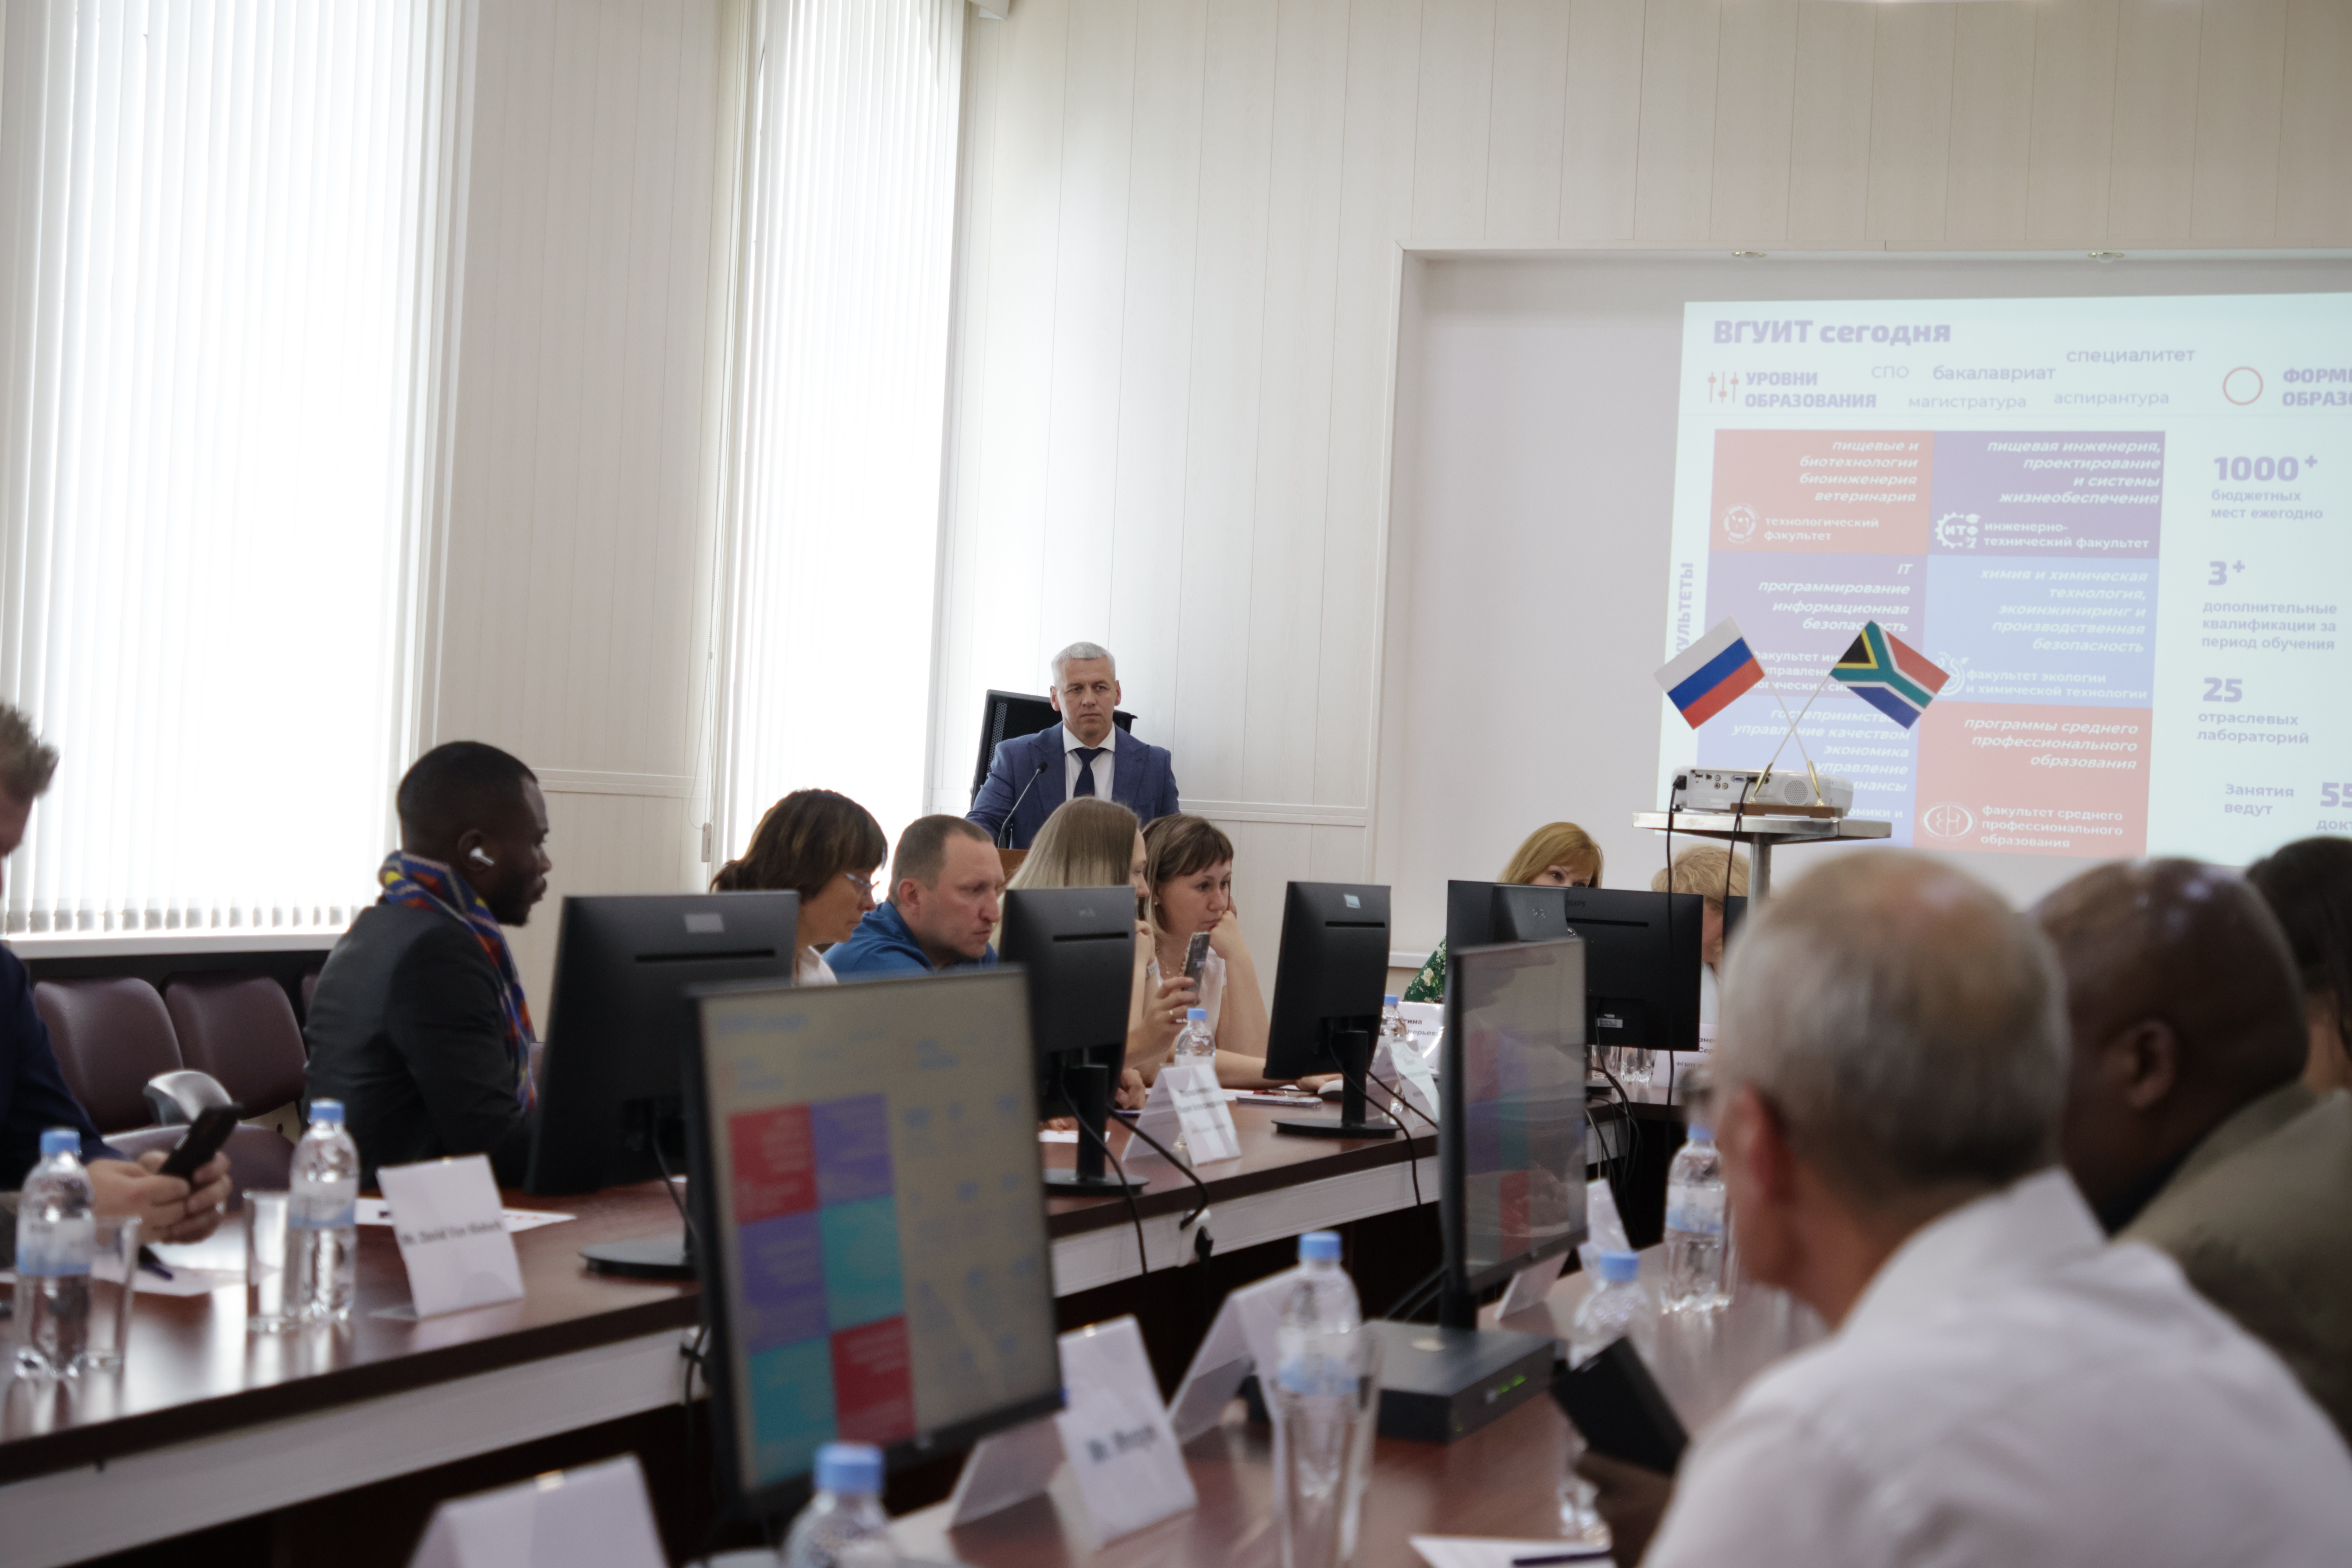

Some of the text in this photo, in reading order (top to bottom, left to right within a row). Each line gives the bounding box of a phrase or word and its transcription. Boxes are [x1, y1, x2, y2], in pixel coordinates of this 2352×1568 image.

[1714, 320, 1951, 347] ВГУИТ сегодня
[2067, 350, 2196, 364] специалитет
[1746, 372, 1818, 386] УРОВНИ
[1871, 365, 2056, 383] СПО бакалавриат
[1745, 394, 1877, 408] ОБРАЗОВАНИЯ
[1909, 397, 2026, 410] магистратура
[2054, 394, 2169, 407] аспирантура
[1832, 442, 1919, 452] пищевые и
[1987, 442, 2161, 454] пищевая инженерия,
[1799, 456, 1918, 468] биотехнологии
[2024, 459, 2161, 471] проектирование
[1799, 472, 1918, 486] биоинженерия
[2073, 477, 2160, 487] и системы
[1815, 492, 1916, 504] ветеринария
[1999, 491, 2160, 504] жизнеобеспечения
[2211, 489, 2301, 502] бюджетных
[2211, 509, 2323, 521] мест ежегодно
[1766, 517, 1879, 528] технологический
[1985, 523, 2068, 534] инженерно-
[1764, 532, 1832, 542] факультет
[1984, 537, 2149, 550] технический факультет
[1897, 564, 1913, 575] IT
[1980, 570, 2148, 582] химия и химическая
[1758, 582, 1911, 594] программирование
[2049, 589, 2146, 601] технология,
[1676, 563, 1693, 656] УЛЬТЕТЫ
[1773, 601, 1909, 615] информационная
[1999, 605, 2146, 619] экоинжиниринг и
[2203, 603, 2337, 614] дополнительные
[1992, 621, 2146, 635] производственная
[2203, 618, 2336, 633] квалификации за
[2033, 638, 2144, 653] безопасность
[2202, 637, 2335, 652] период обучения
[1966, 670, 2106, 684] факультет экологии
[1978, 686, 2062, 696] химической
[2066, 688, 2147, 699] технологии
[2202, 677, 2243, 702] 25
[2198, 713, 2299, 725] отраслевых
[1964, 719, 2138, 735] программы среднего
[1828, 729, 1911, 740] качеством
[2196, 729, 2309, 745] лабораторий
[1972, 735, 2138, 751] профессионального
[1824, 746, 1909, 758] экономика
[2031, 754, 2137, 769] образования
[1816, 763, 1909, 775] управление
[2225, 784, 2294, 798] Занятия
[1895, 810, 1904, 818] и
[1982, 804, 2123, 821] факультет среднего
[2225, 804, 2273, 817] ведут
[1982, 819, 2123, 836] профессионального
[1981, 834, 2071, 848] образования
